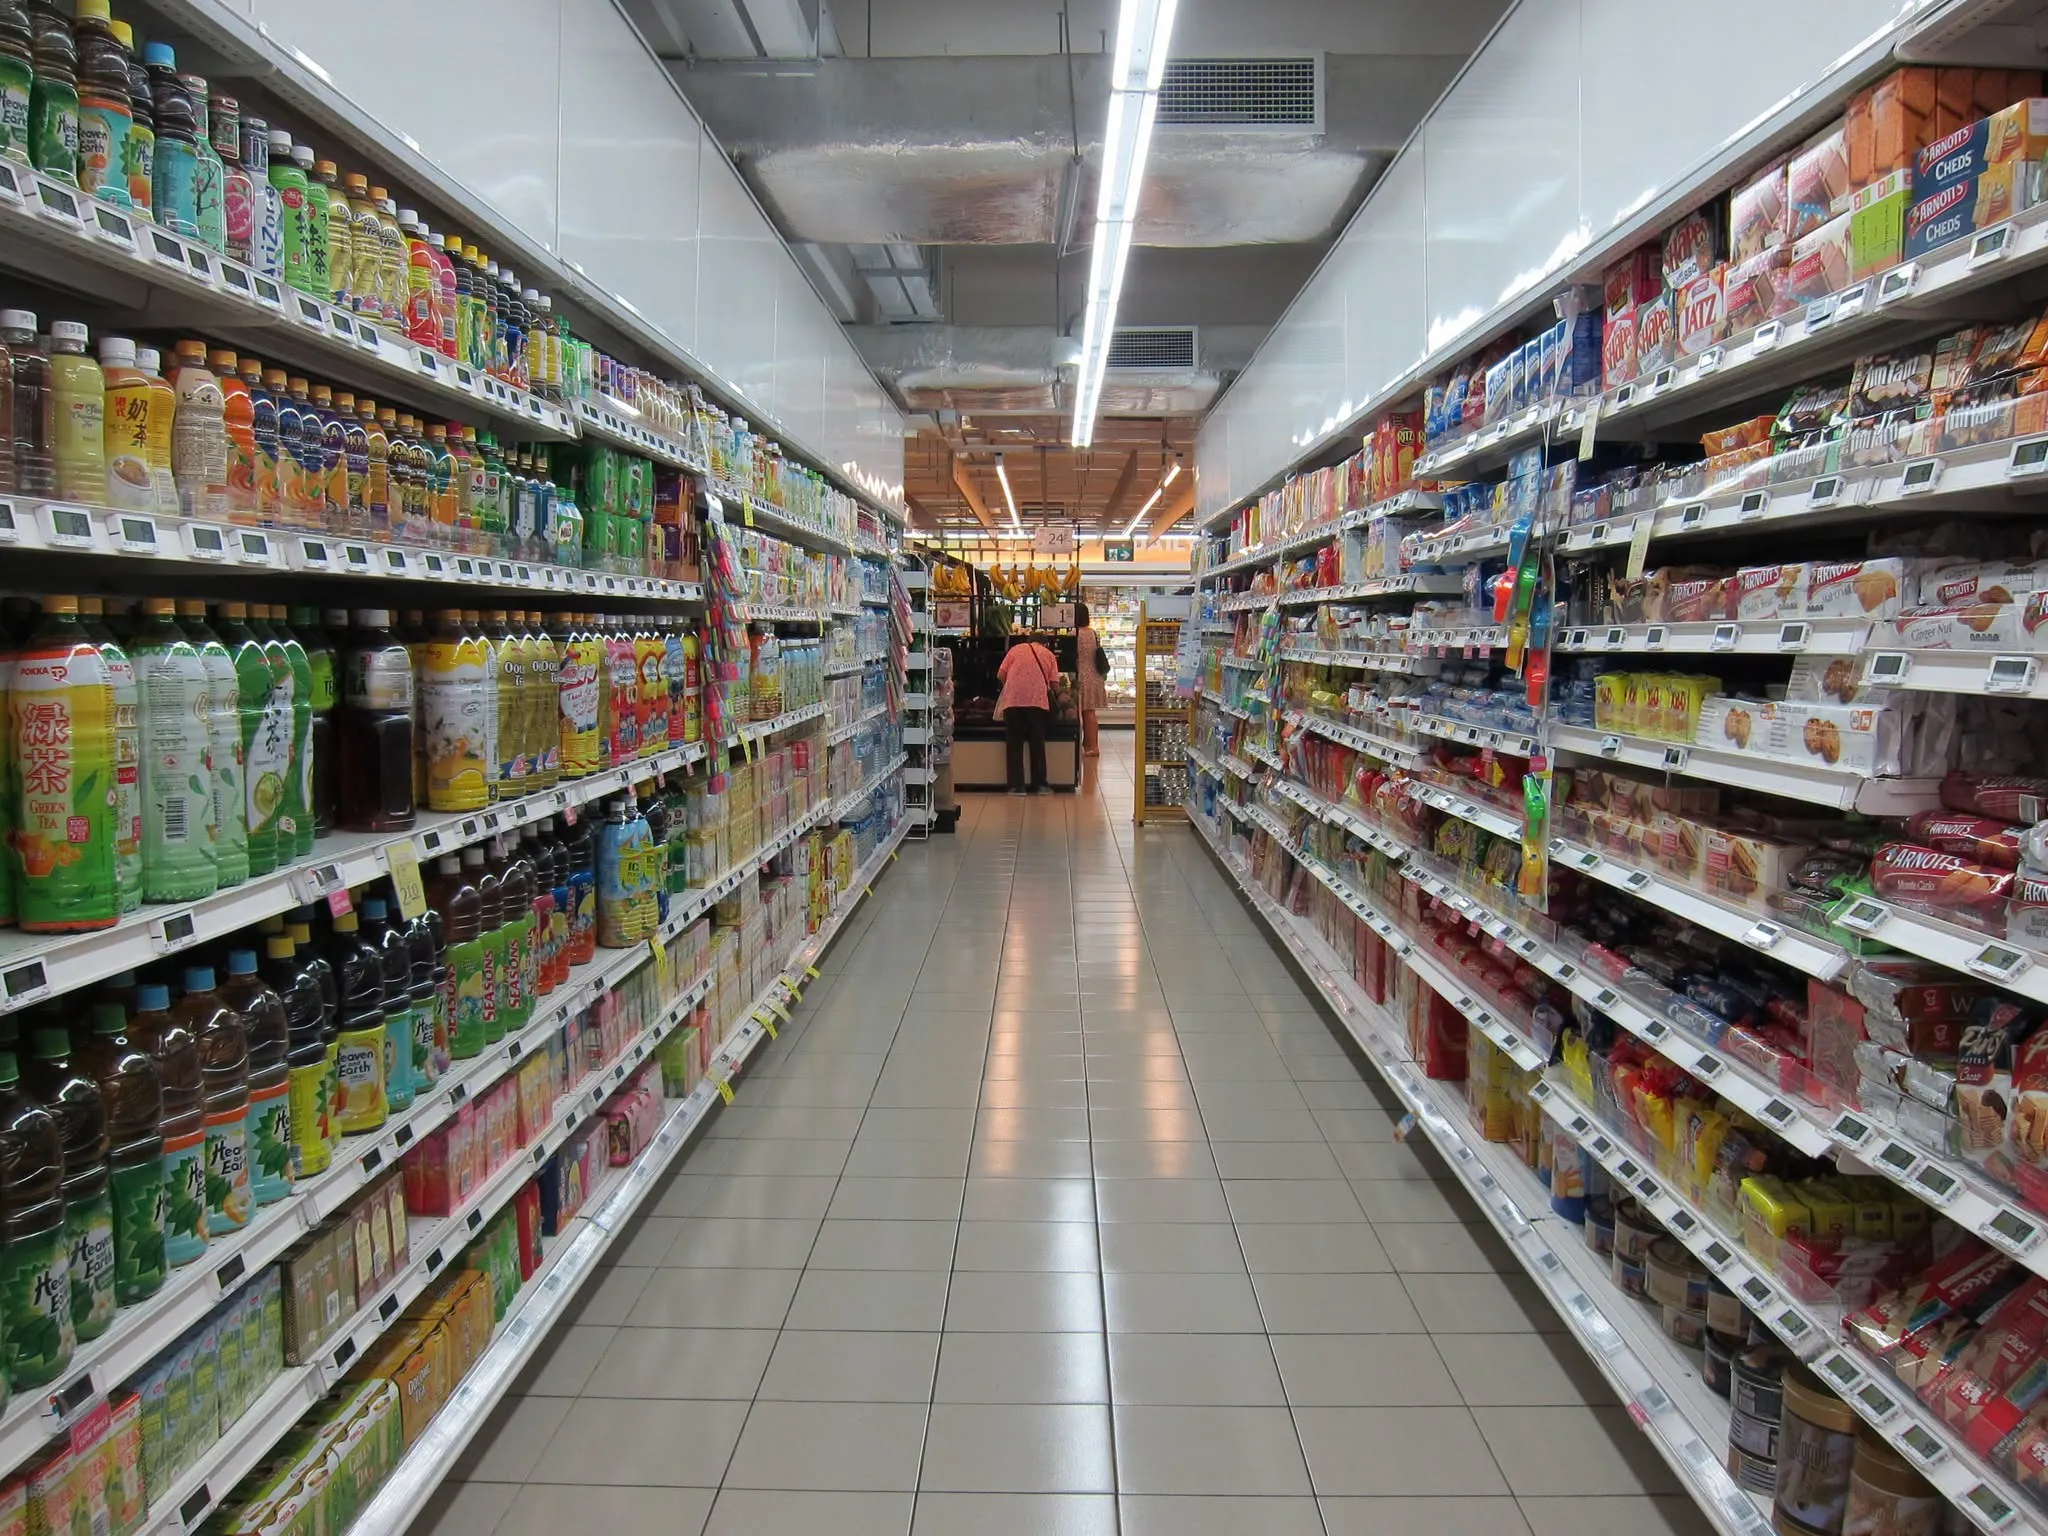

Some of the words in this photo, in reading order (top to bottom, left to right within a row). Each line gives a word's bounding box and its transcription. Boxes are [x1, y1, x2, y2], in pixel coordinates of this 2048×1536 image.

[1935, 151, 1973, 180] CHEDS
[1926, 215, 1961, 242] CHEDS
[1684, 294, 1718, 339] JATZ
[126, 397, 149, 448] 奶茶
[1399, 430, 1413, 443] RITZ
[1911, 626, 1938, 641] Ginger
[1938, 622, 1952, 634] Nut
[21, 666, 49, 676] POKKA
[29, 800, 66, 814] GREEN
[38, 817, 58, 829] TEA
[509, 938, 521, 1009] SEASONS
[482, 950, 496, 1022] SEASONS
[338, 1060, 371, 1078] Earth
